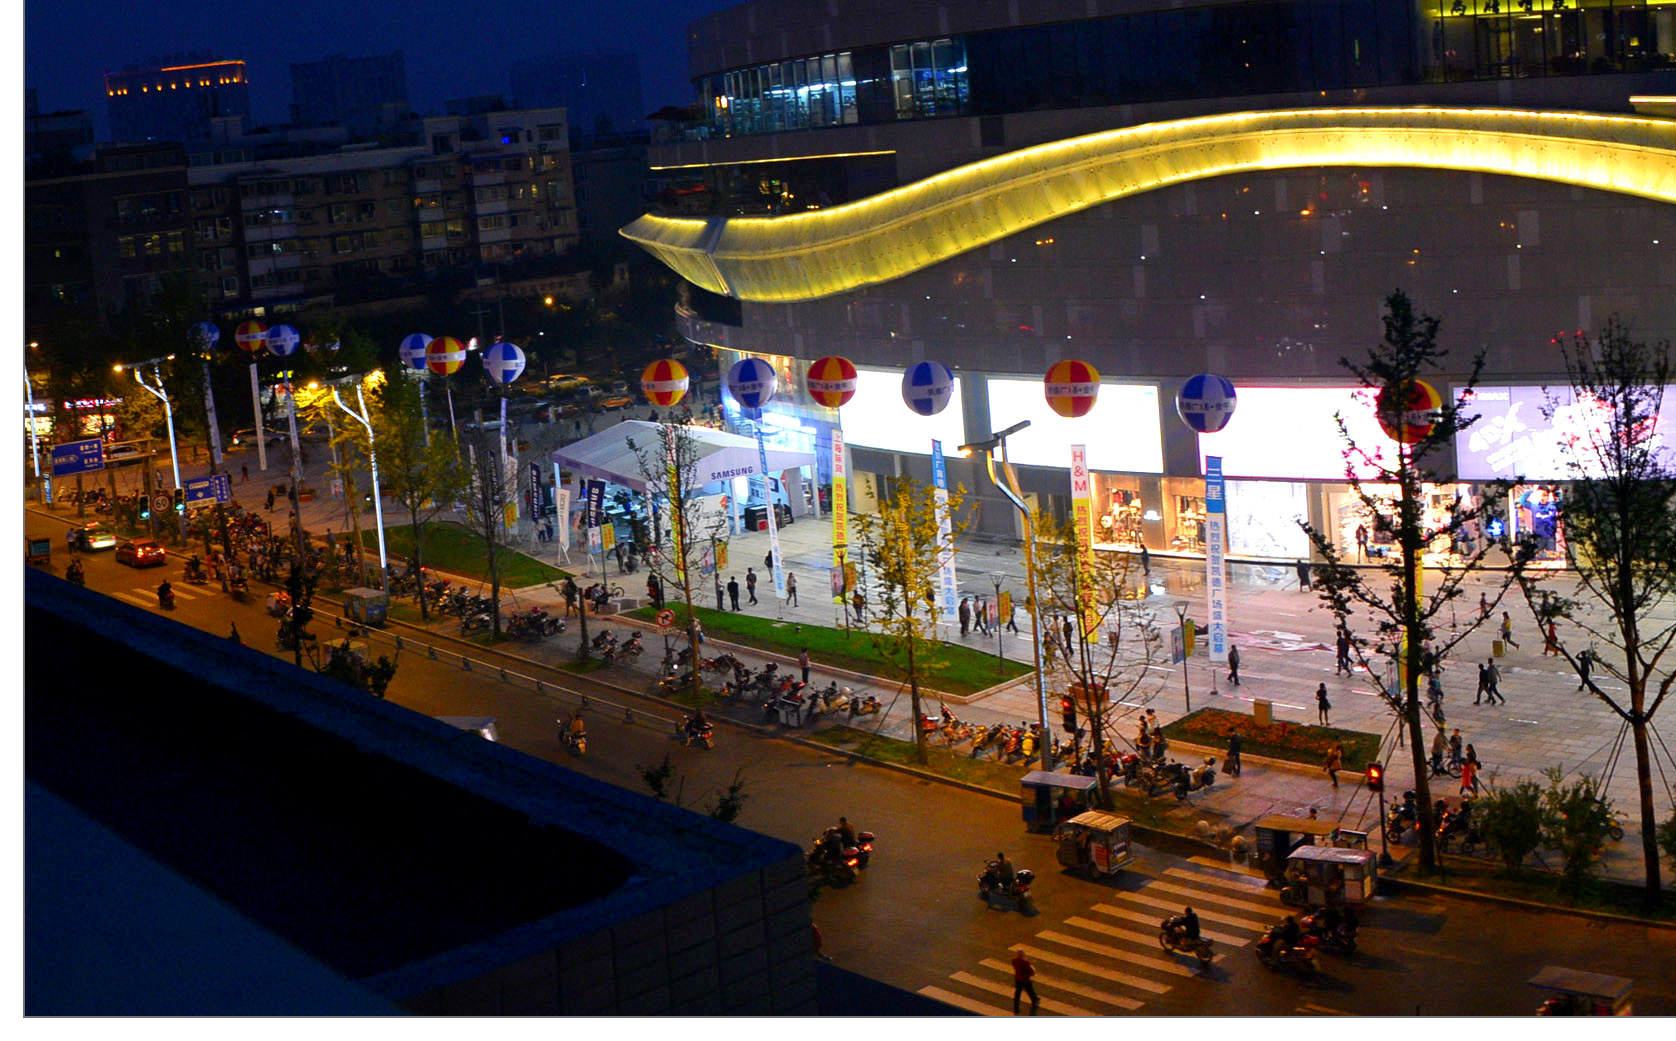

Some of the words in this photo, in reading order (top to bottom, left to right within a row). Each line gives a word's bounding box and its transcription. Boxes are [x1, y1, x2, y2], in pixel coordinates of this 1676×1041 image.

[711, 466, 754, 480] SAMSUNG
[1072, 450, 1087, 493] H&M
[1207, 467, 1222, 501] 三星
[155, 496, 168, 510] 60
